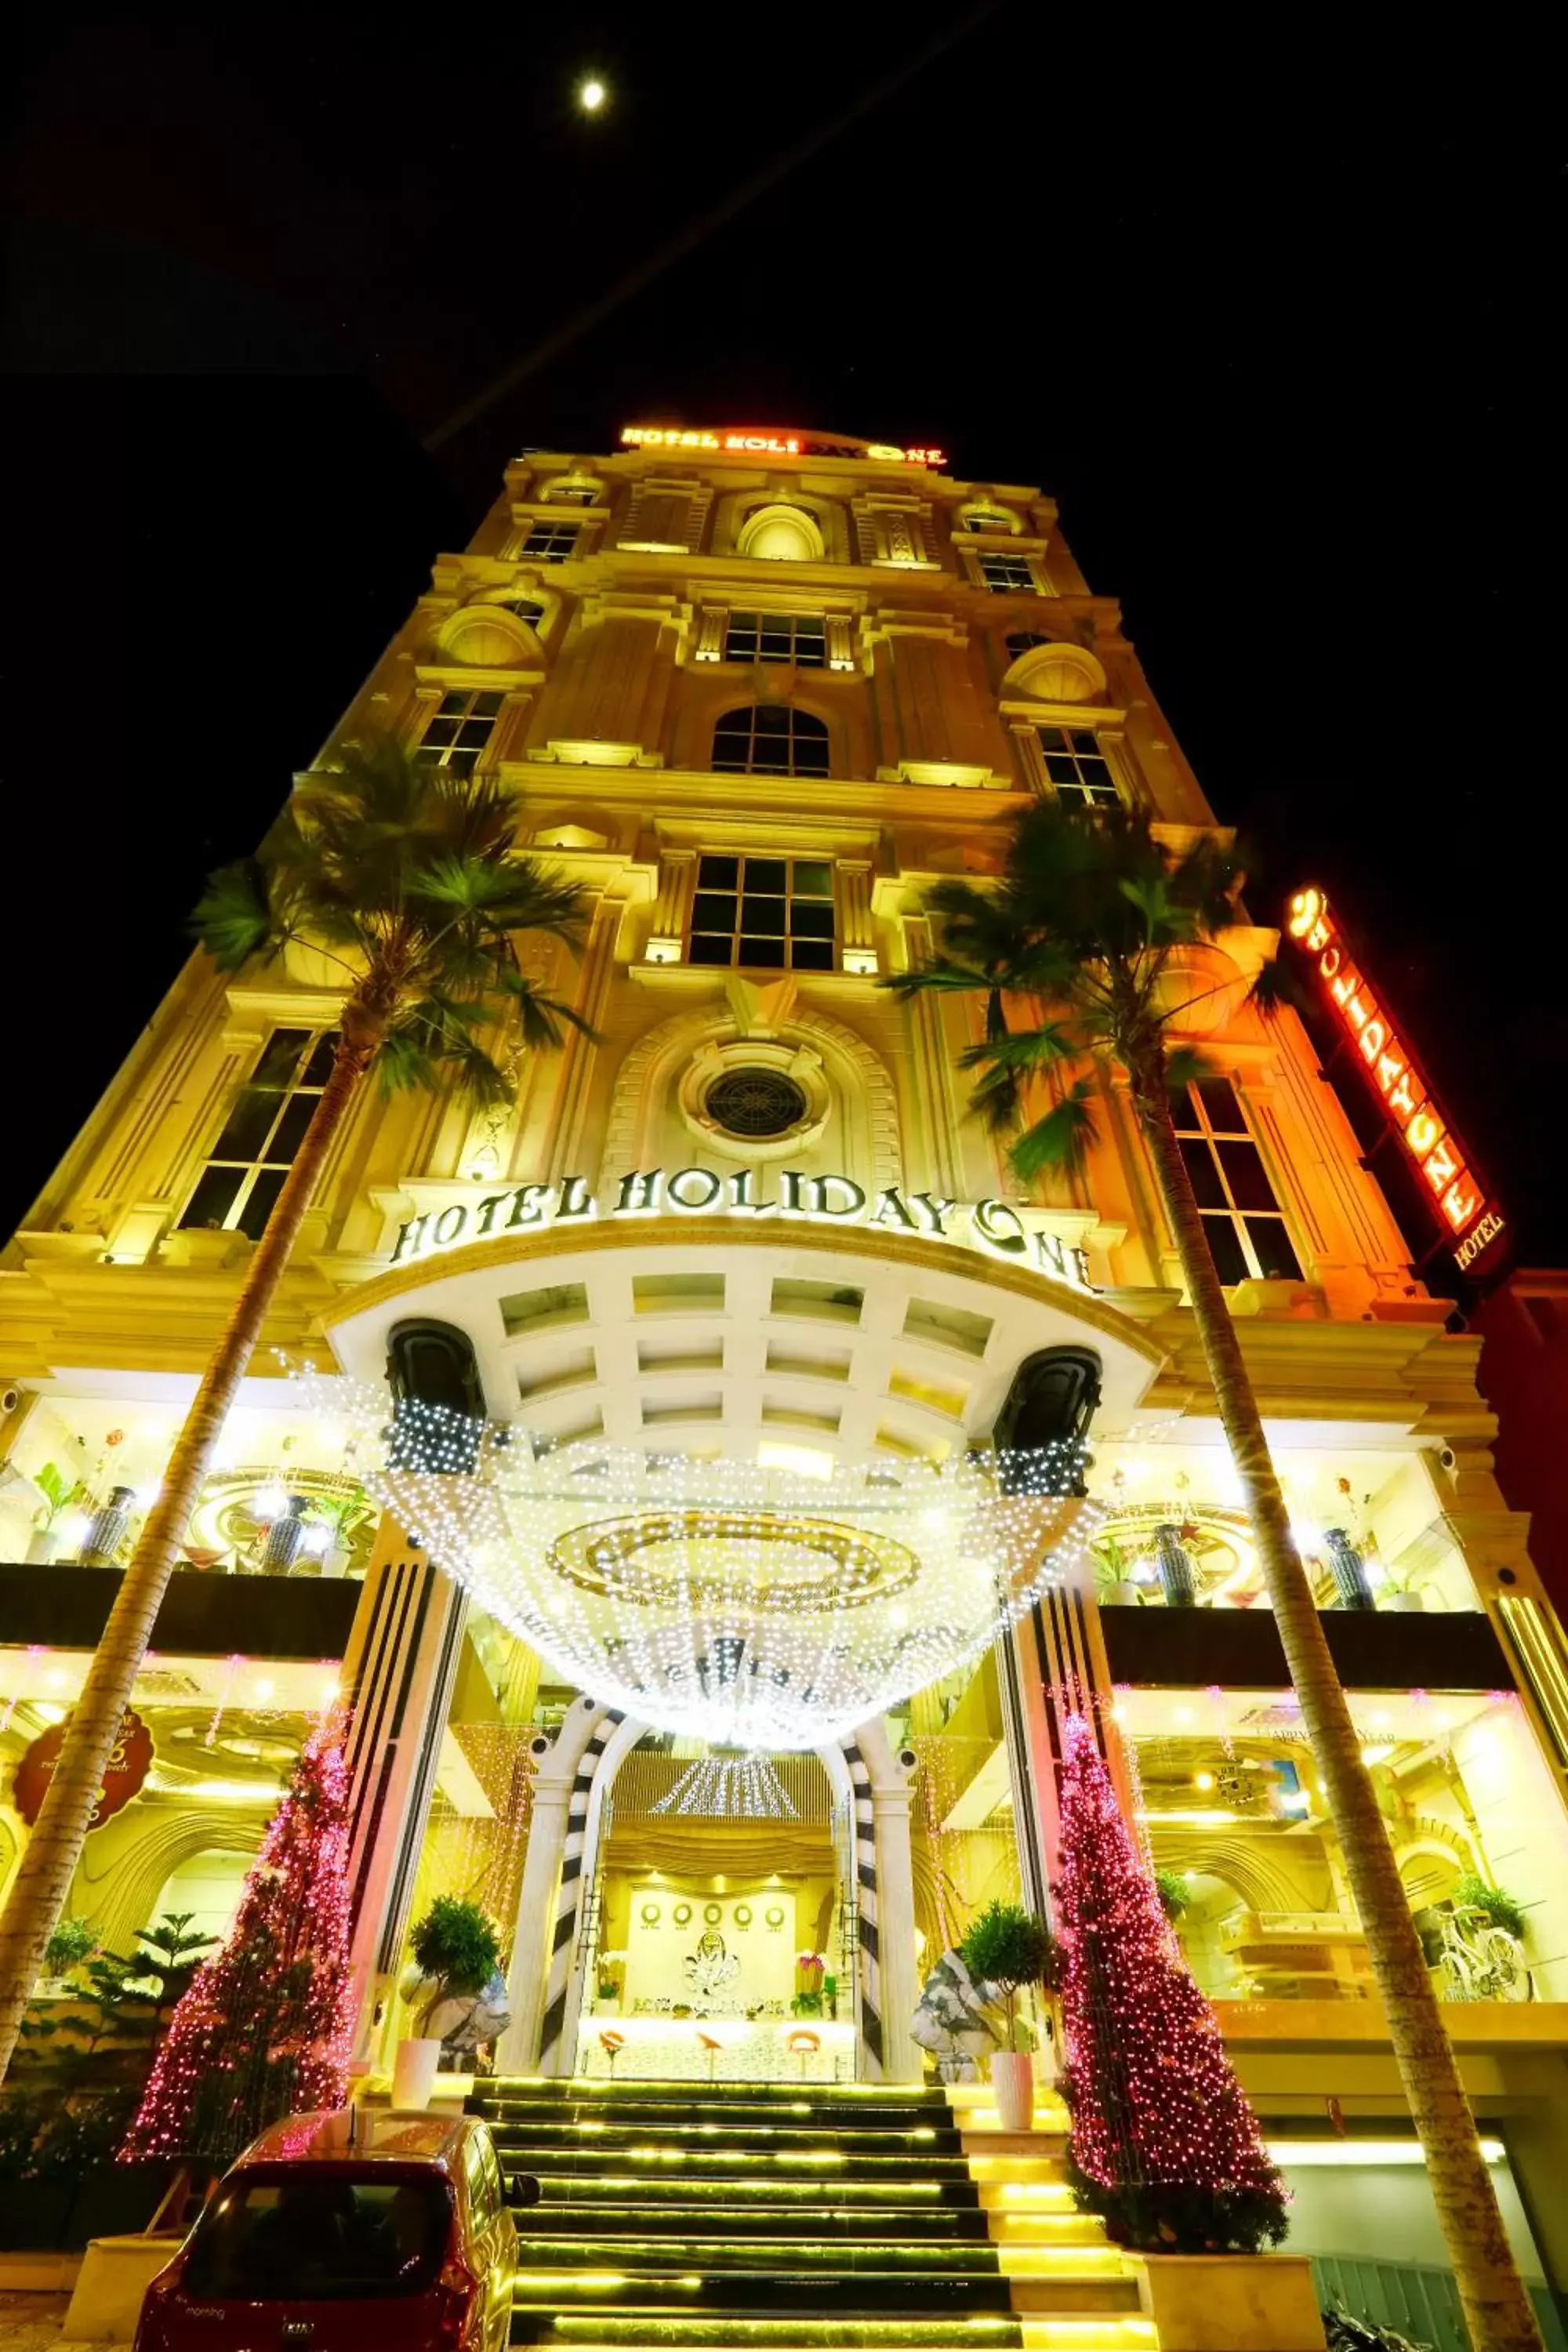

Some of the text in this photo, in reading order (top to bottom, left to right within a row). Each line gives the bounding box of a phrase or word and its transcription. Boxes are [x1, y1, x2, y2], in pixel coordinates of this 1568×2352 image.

[622, 428, 719, 449] HOTEL
[1307, 917, 1475, 1227] HOLIDAY ONE
[389, 1167, 1105, 1294] HOTEL HOLIDAY ONE
[1454, 1213, 1506, 1272] HOTEL
